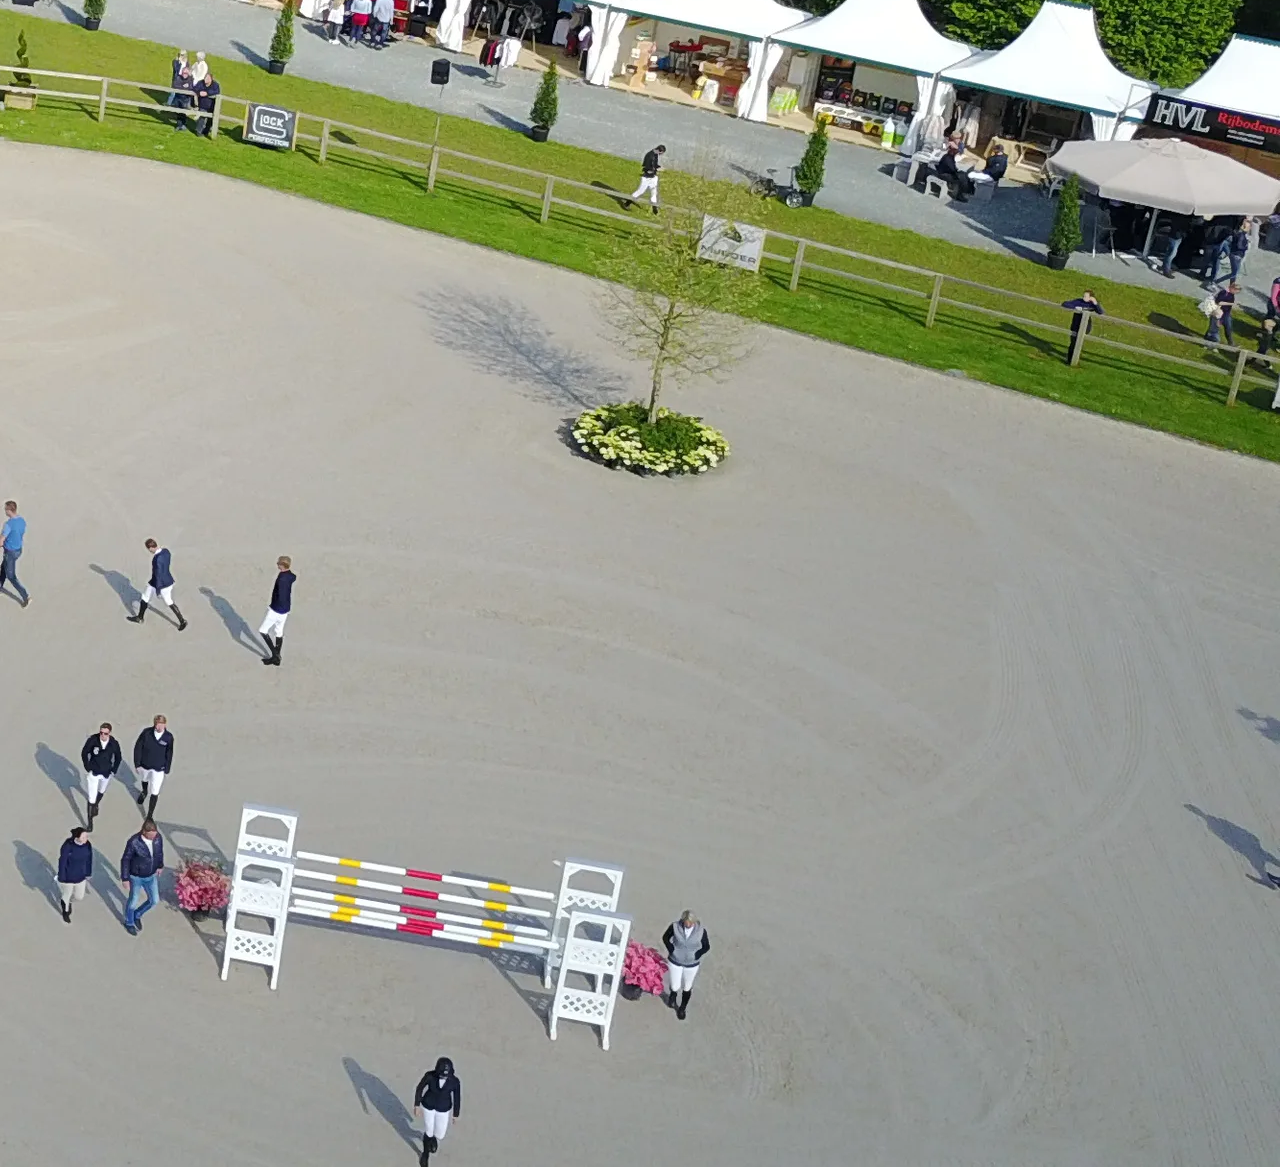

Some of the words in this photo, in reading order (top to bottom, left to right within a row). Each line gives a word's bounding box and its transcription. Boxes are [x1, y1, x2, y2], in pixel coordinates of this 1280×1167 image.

[252, 105, 289, 139] GLOCK
[1152, 99, 1211, 133] HVL
[247, 133, 290, 148] PERFECTION
